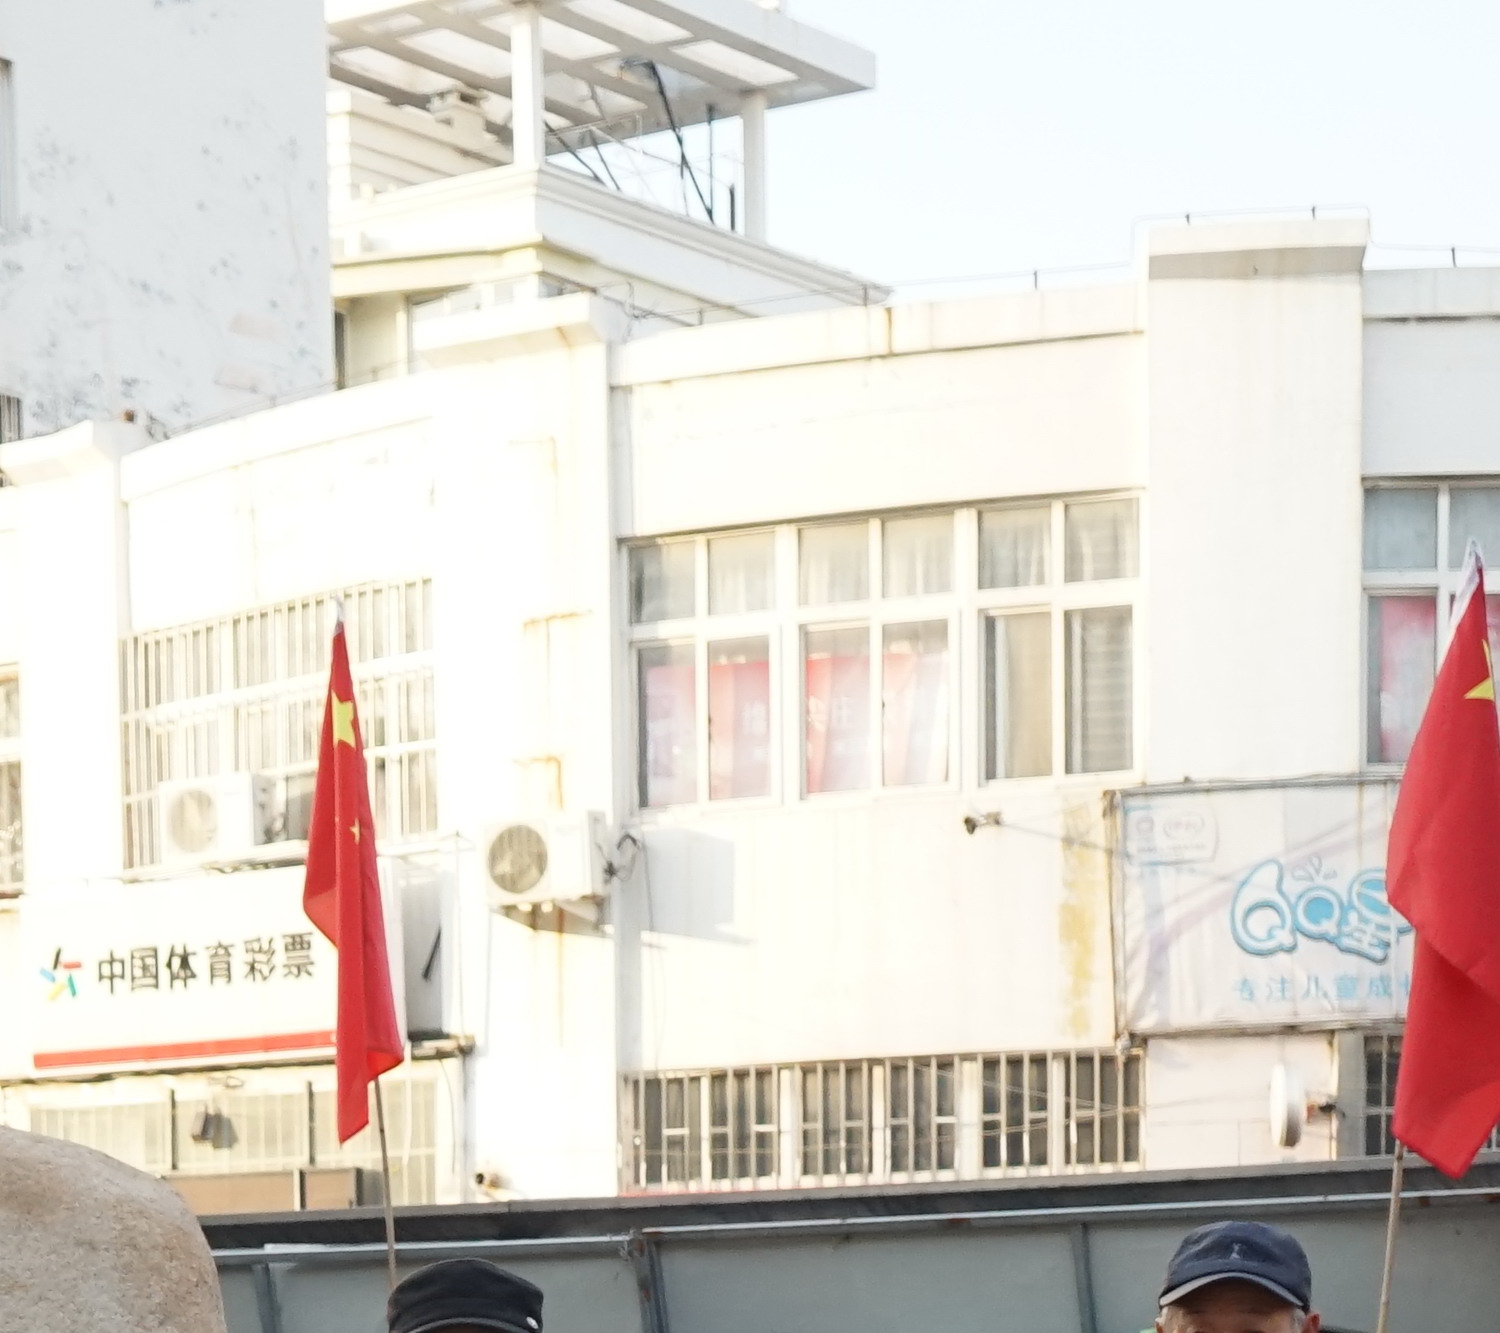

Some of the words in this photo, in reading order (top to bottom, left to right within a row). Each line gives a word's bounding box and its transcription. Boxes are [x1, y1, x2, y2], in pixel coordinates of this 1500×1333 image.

[97, 931, 315, 995] 中国体育彩票
